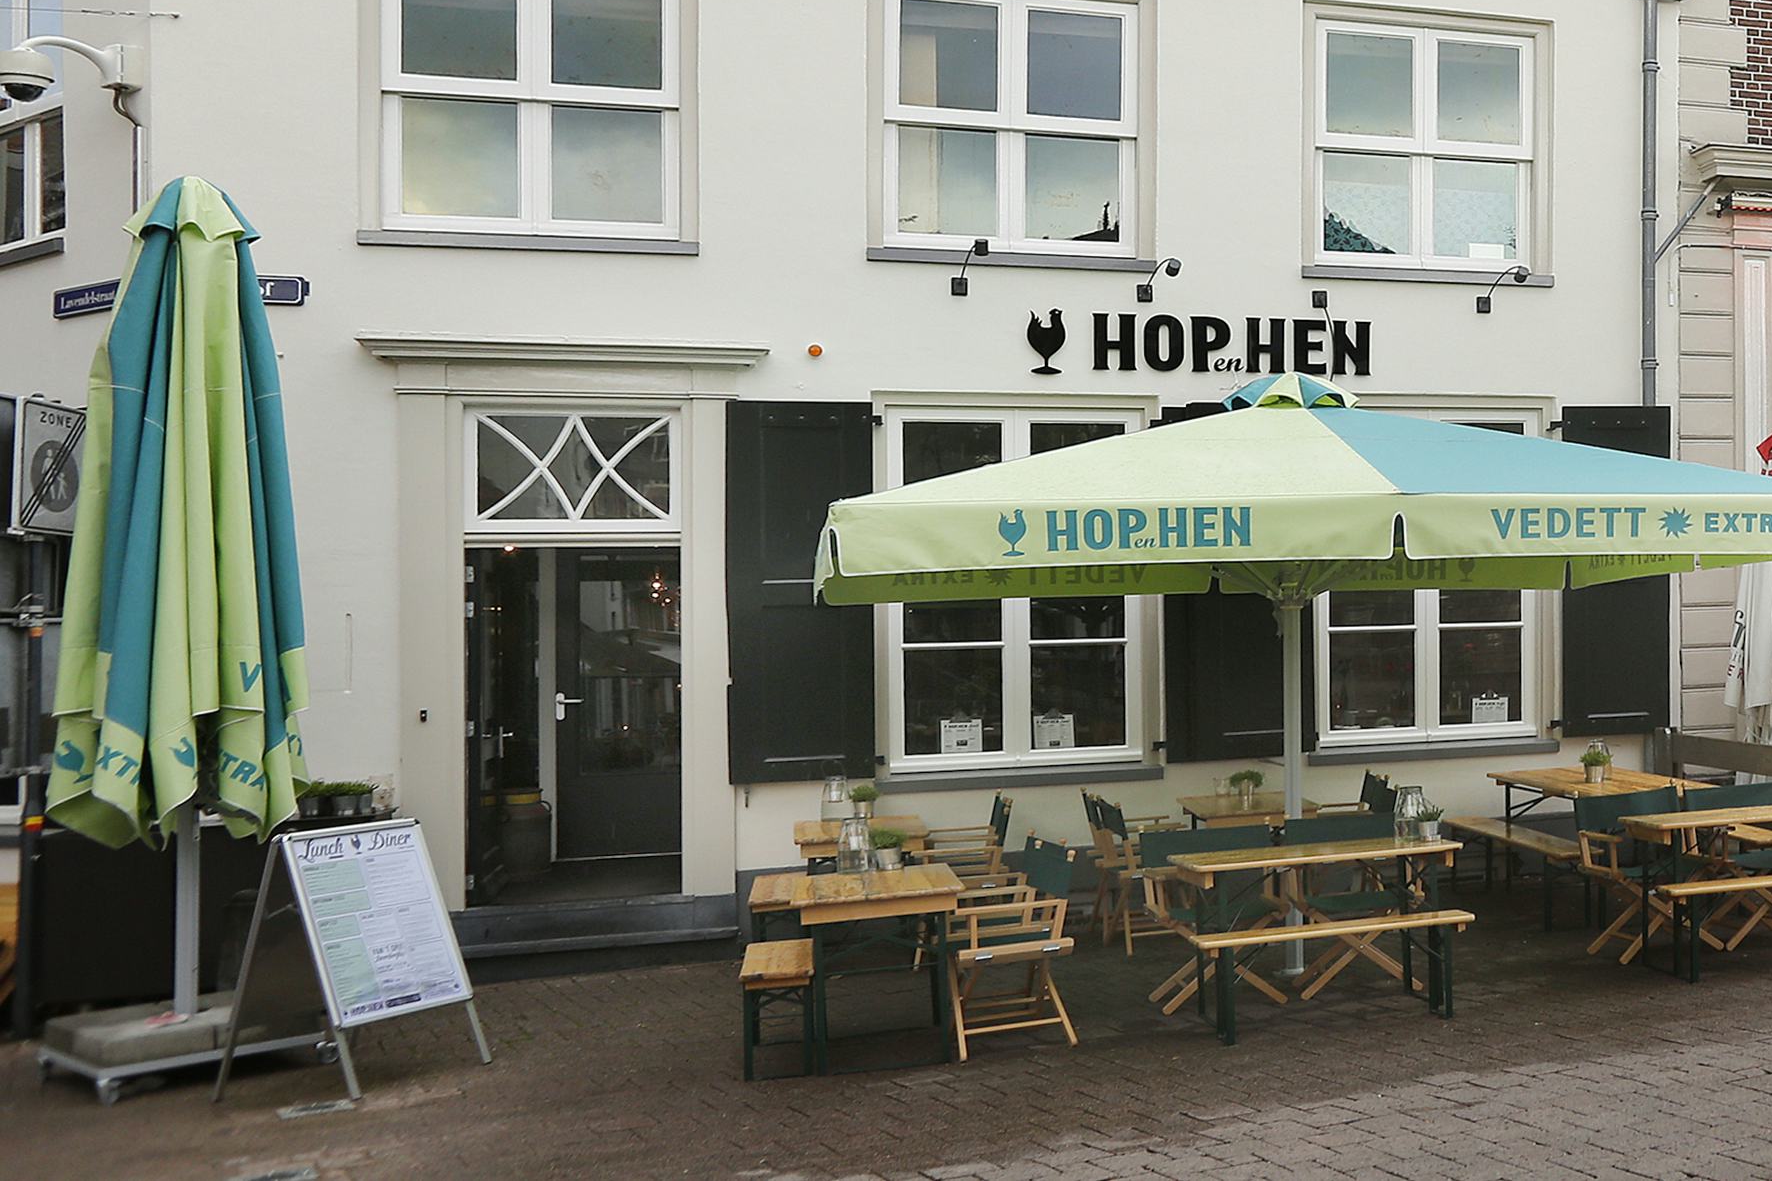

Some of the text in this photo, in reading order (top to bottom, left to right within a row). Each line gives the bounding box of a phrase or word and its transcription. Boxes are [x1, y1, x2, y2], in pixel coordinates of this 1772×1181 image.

[1092, 312, 1372, 376] HOP en HEN
[40, 411, 73, 429] ZONE
[1046, 507, 1252, 552] HOP en HEN
[1490, 507, 1647, 540] VEDETT
[297, 830, 412, 863] Lunch Diner
